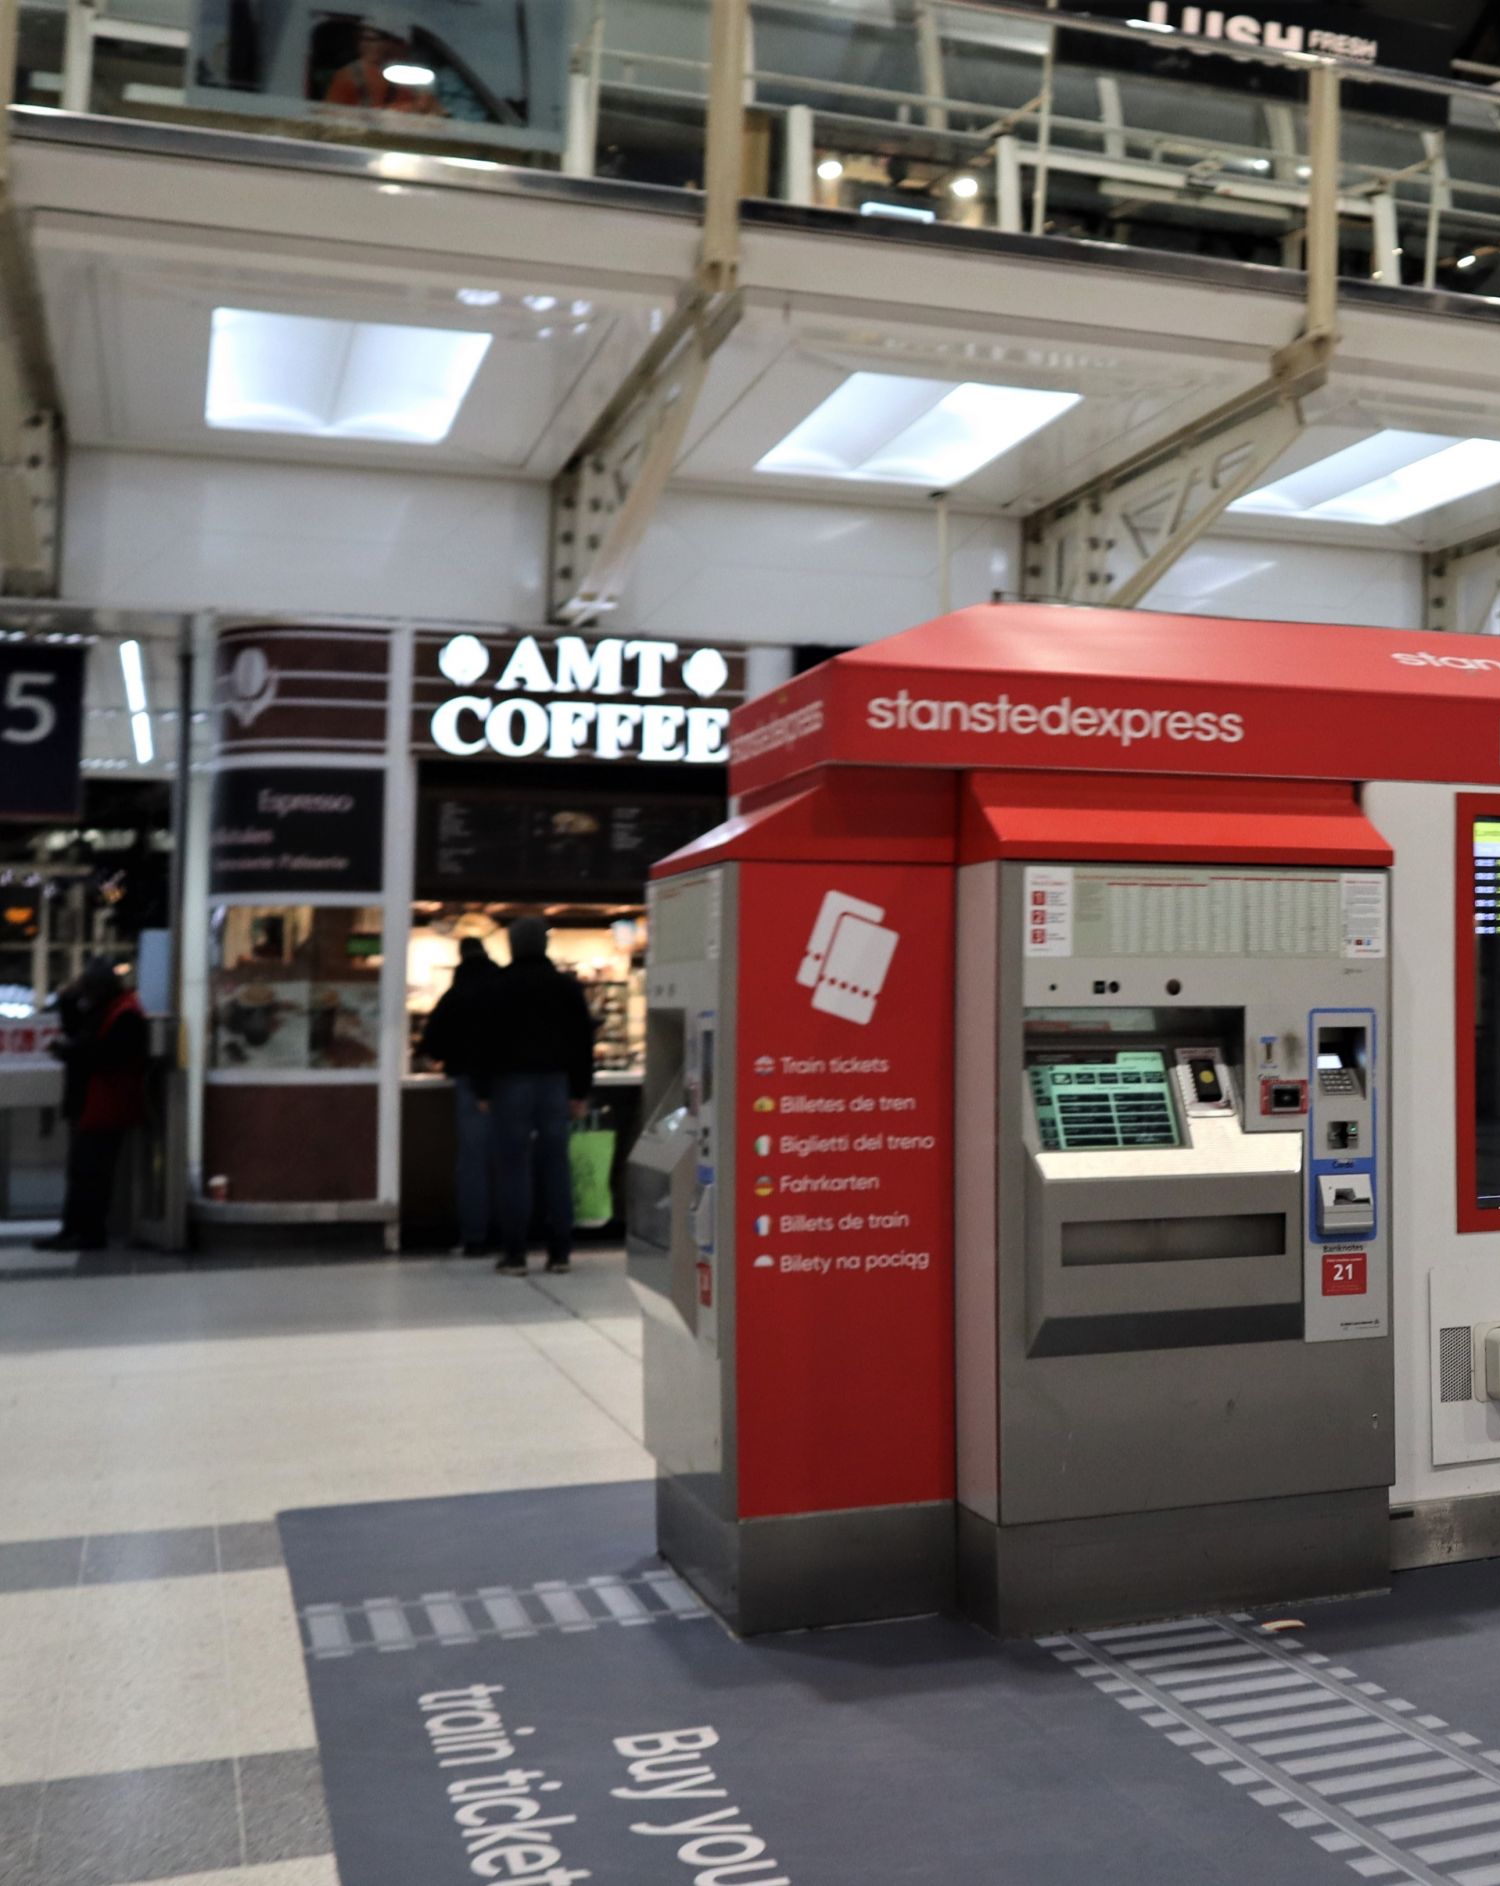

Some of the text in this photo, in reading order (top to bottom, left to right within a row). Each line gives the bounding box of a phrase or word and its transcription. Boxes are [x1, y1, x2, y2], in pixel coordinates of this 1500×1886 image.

[495, 635, 679, 697] AMT
[3, 671, 56, 744] 5
[866, 689, 1245, 748] stanstedexpress
[430, 695, 732, 764] COFFEE
[780, 1055, 889, 1073] Train tickets
[780, 1095, 917, 1113] Billetes de tren
[780, 1134, 935, 1157] Biglietti del treno
[780, 1175, 880, 1193] Fahrkarten
[780, 1211, 909, 1232] Billets de train
[780, 1255, 832, 1273] Bilety
[836, 1255, 861, 1270] na
[1333, 1264, 1353, 1281] 21
[417, 1683, 593, 1886] train ticket
[610, 1725, 792, 1886] Buy you
